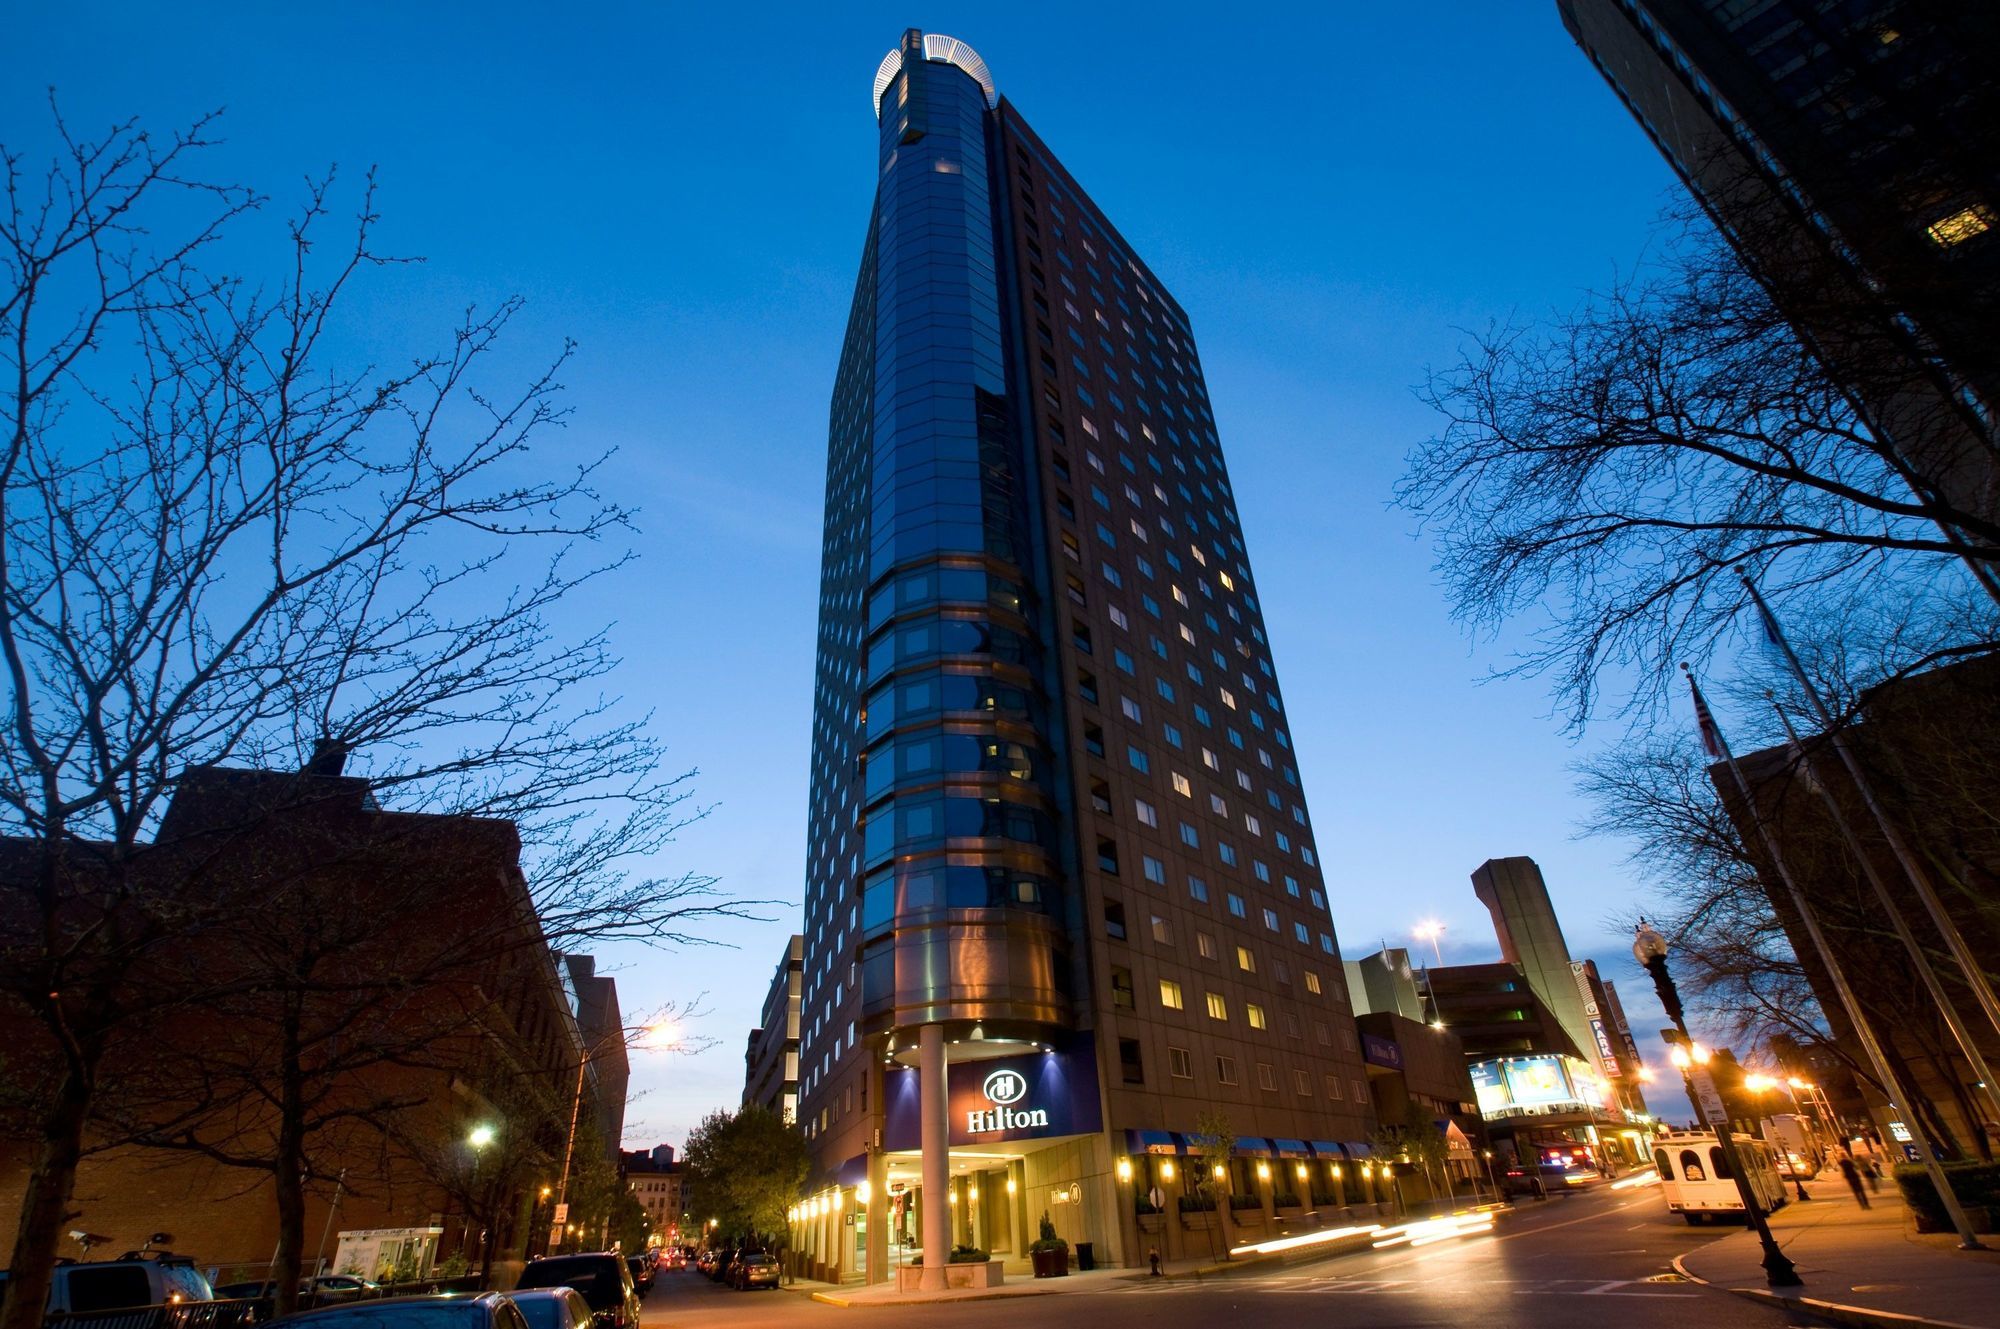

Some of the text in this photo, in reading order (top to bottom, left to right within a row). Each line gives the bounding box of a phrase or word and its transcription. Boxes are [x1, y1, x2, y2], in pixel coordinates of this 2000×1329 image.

[1592, 1021, 1612, 1057] PARK
[1624, 1035, 1640, 1064] PAR
[1605, 1060, 1617, 1070] 24
[967, 1105, 1049, 1133] Hilton
